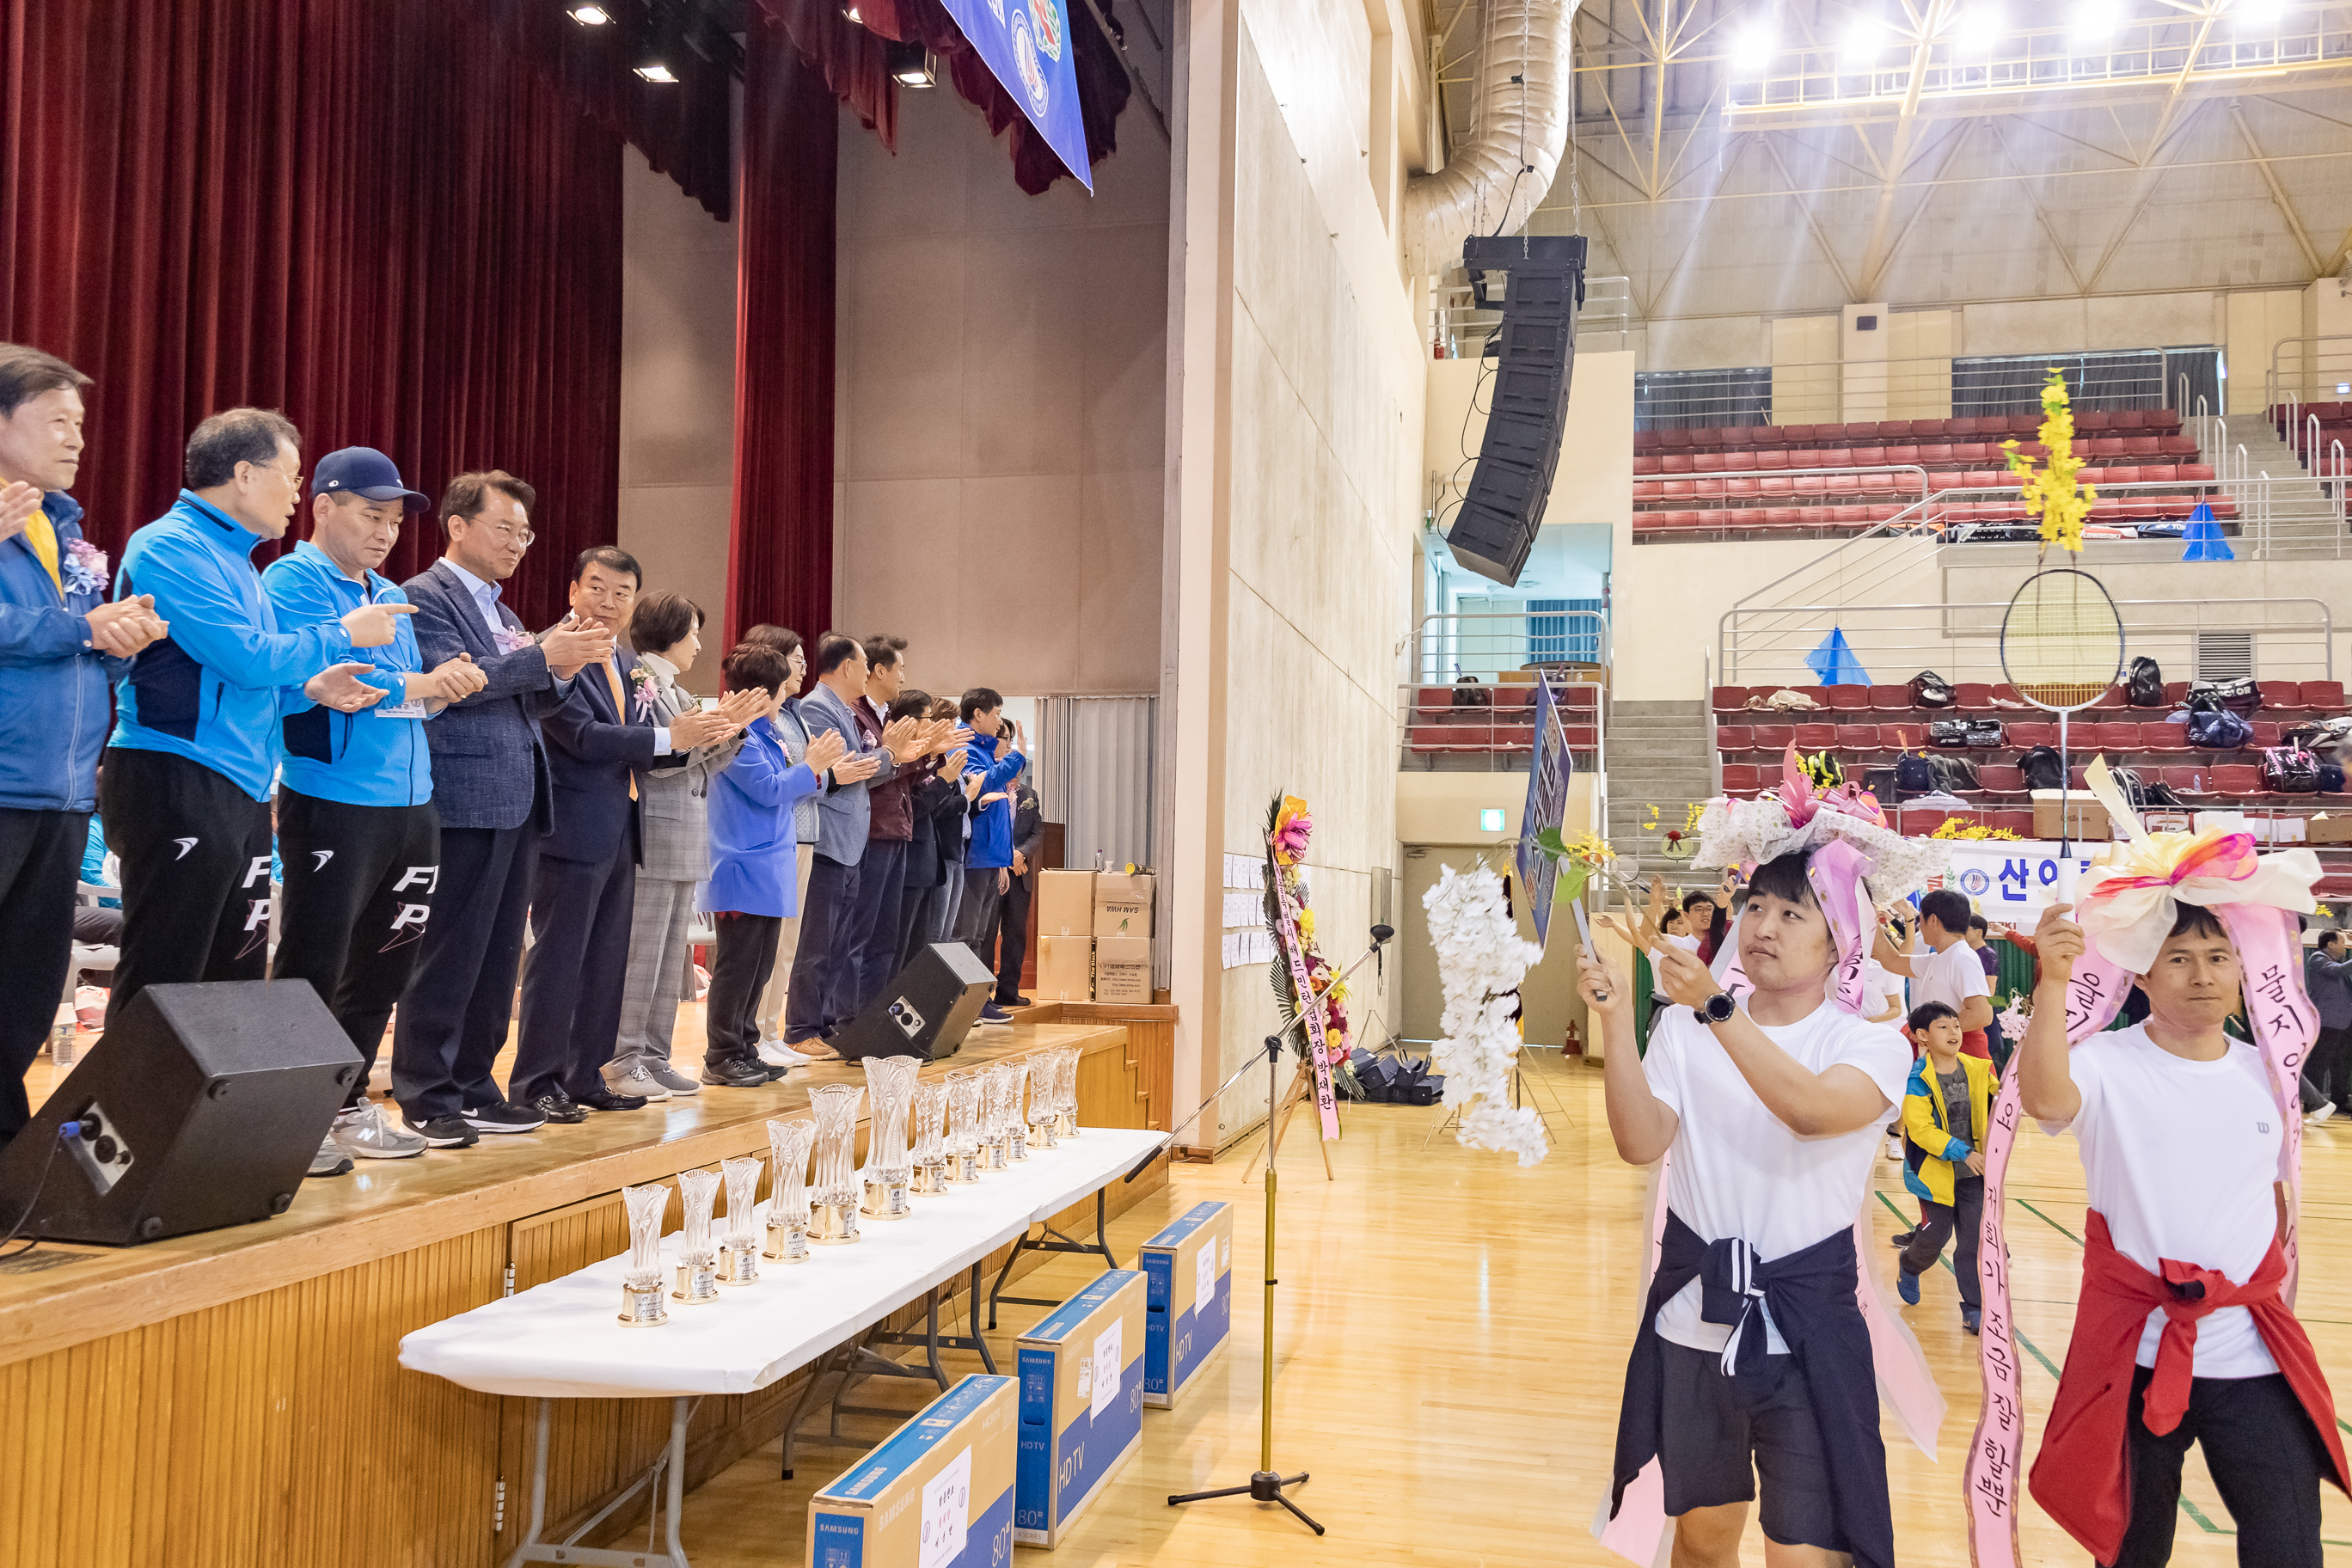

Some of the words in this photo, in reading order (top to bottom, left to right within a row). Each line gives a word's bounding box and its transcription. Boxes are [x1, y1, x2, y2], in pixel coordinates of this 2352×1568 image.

[1317, 1060, 1332, 1110] 박재환
[357, 1127, 377, 1142] N
[1021, 1356, 1052, 1364] SAMSUNG
[844, 1467, 888, 1497] SAMSUNG
[879, 1486, 916, 1533] SAMSUNG
[1017, 1509, 1037, 1527] 80
[819, 1523, 859, 1535] SAMSUNG
[992, 1527, 1006, 1568] 80
